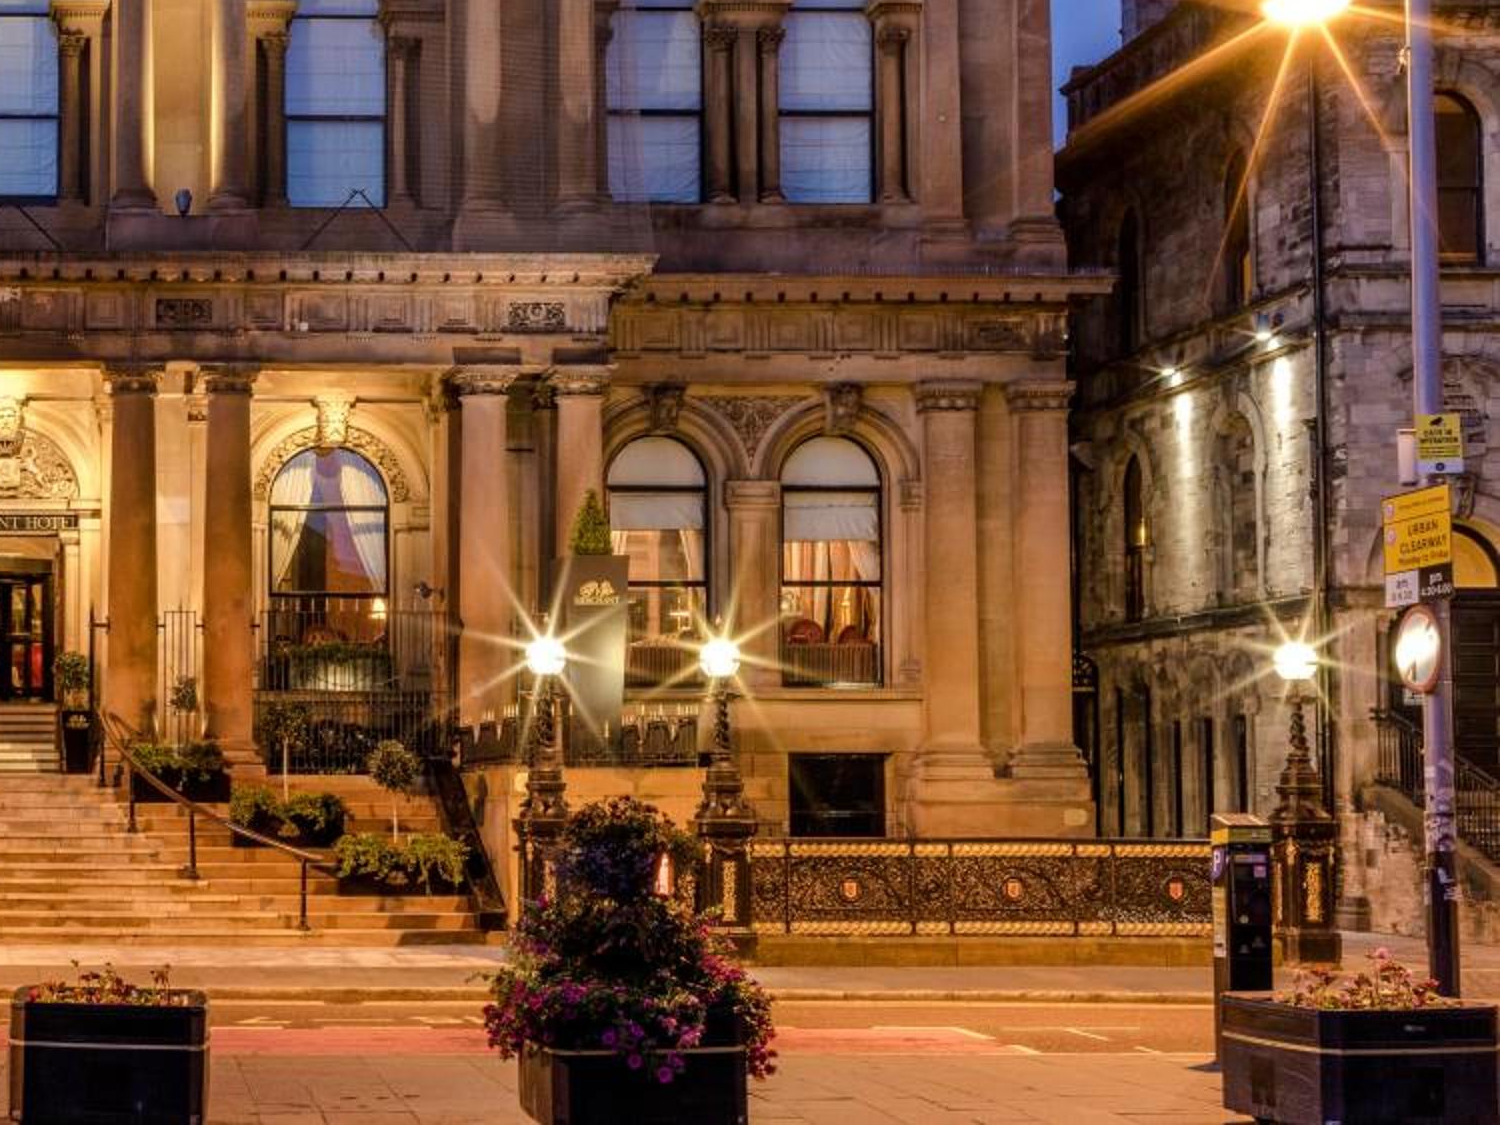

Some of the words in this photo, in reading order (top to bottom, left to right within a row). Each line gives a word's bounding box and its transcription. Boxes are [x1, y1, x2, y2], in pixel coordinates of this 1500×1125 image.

[26, 515, 78, 531] HOTEL
[1407, 518, 1439, 537] URBAN
[1399, 534, 1447, 555] CLEARWAY
